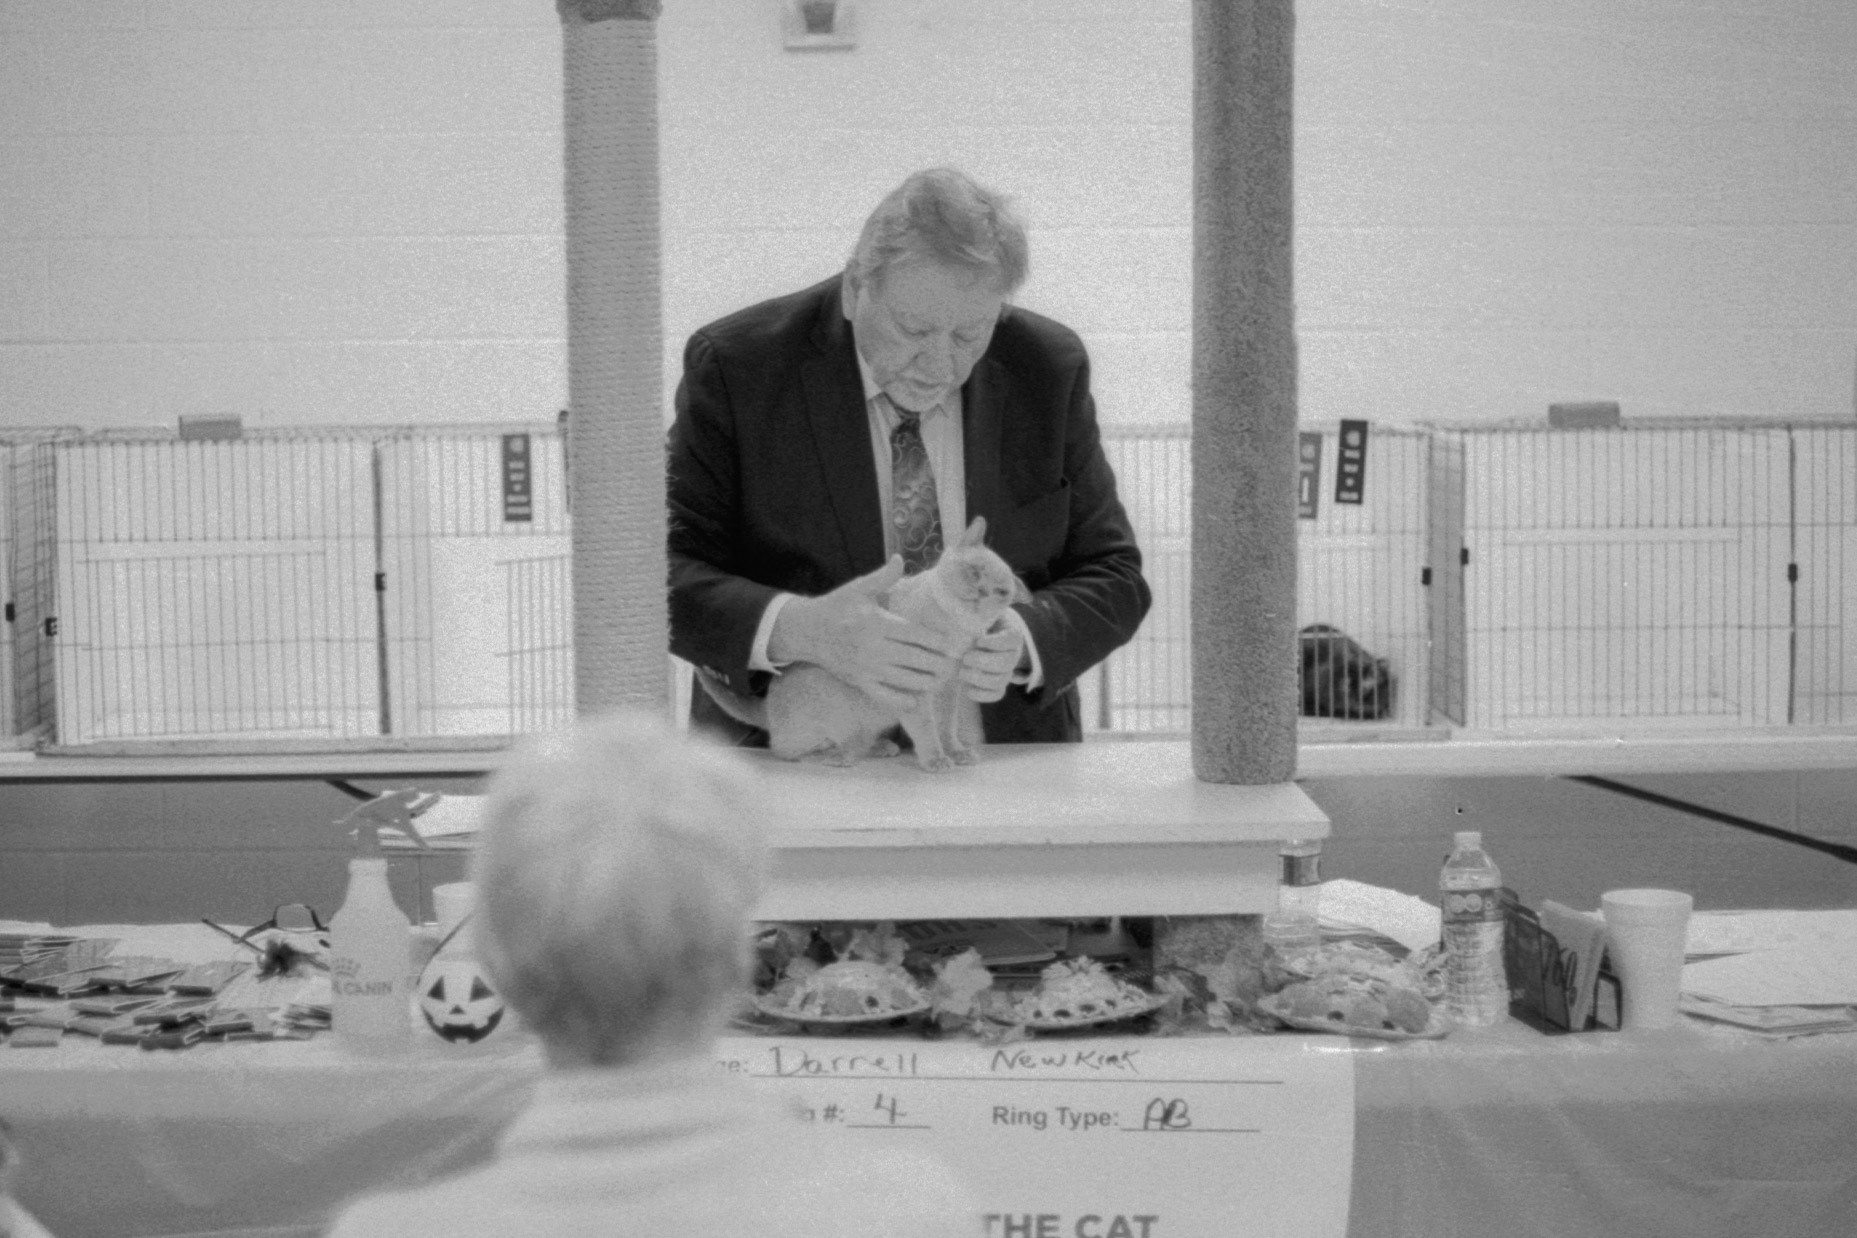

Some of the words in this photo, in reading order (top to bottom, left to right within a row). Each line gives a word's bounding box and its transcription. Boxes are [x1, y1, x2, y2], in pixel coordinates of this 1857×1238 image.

[769, 1046, 918, 1076] Darrell
[873, 1092, 908, 1124] 4
[992, 1105, 1048, 1130] Ring
[1055, 1106, 1121, 1131] Type:
[1142, 1097, 1192, 1131] AB
[982, 1213, 1061, 1238] THE
[1074, 1213, 1160, 1238] CAT
